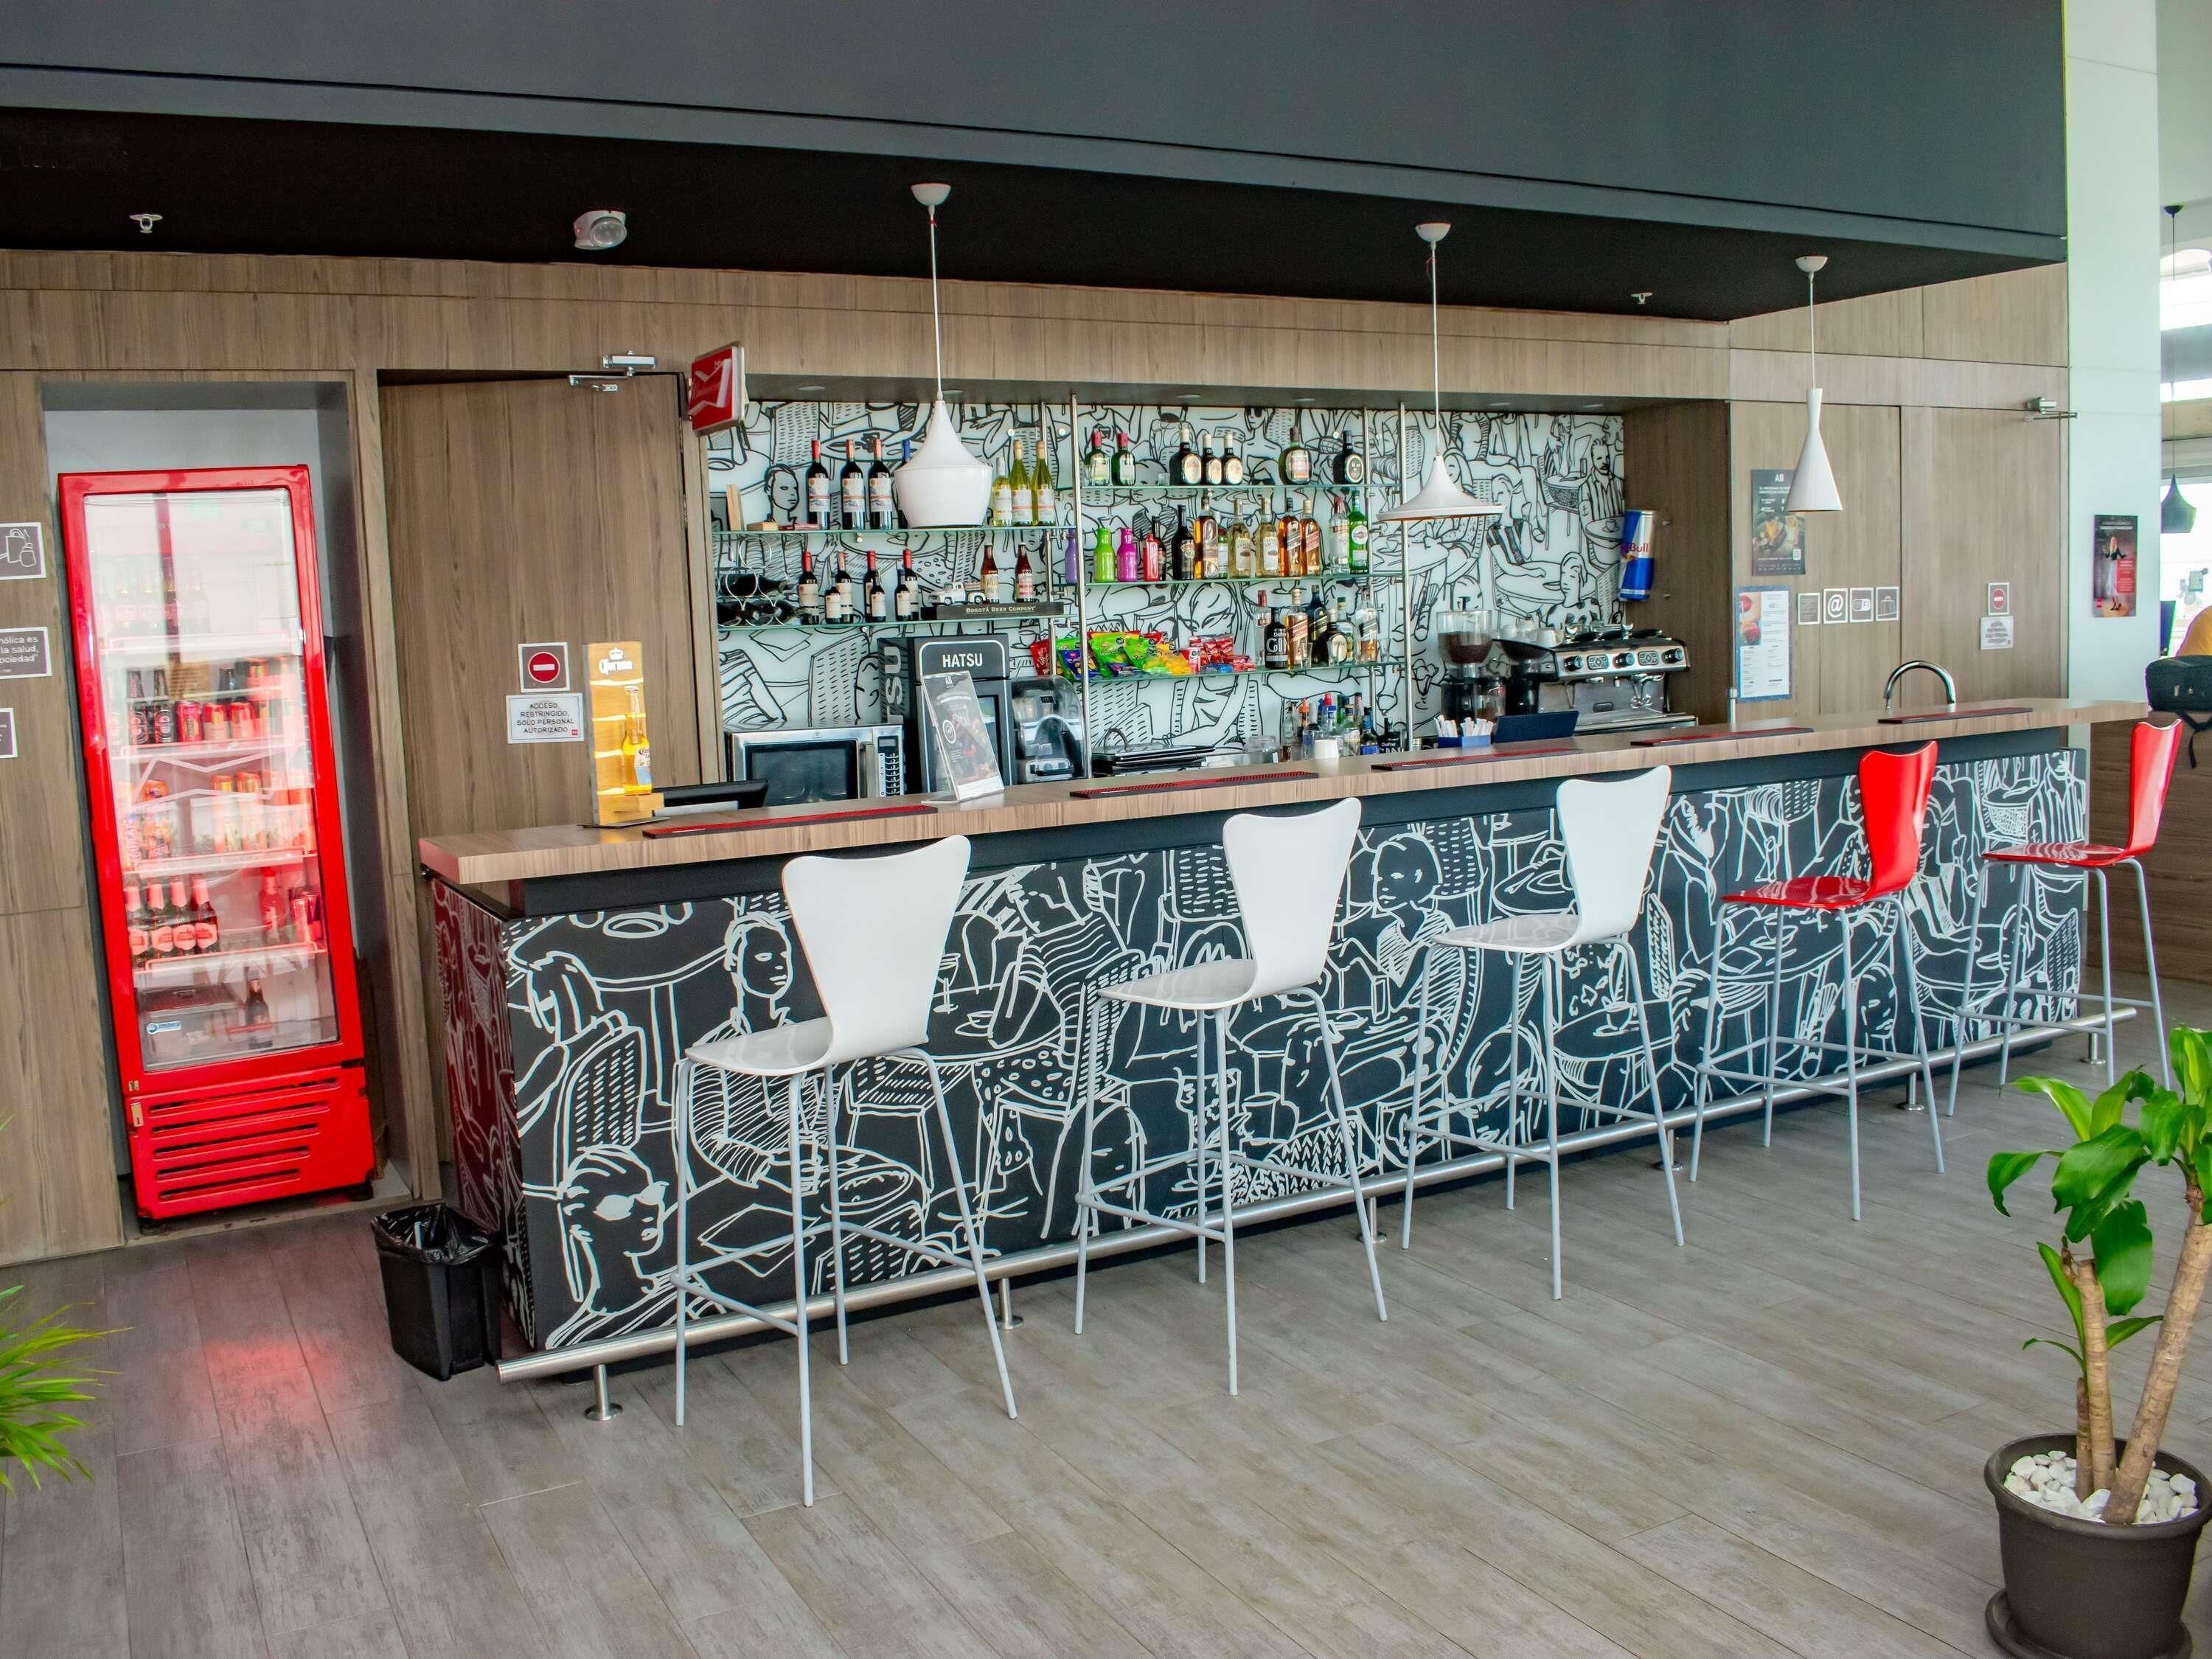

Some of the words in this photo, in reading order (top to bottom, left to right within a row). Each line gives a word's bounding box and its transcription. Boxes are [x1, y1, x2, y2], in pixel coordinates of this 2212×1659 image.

[1630, 543, 1648, 552] Bull
[1, 646, 10, 654] la
[11, 644, 39, 654] salud,
[942, 653, 983, 668] HATSU
